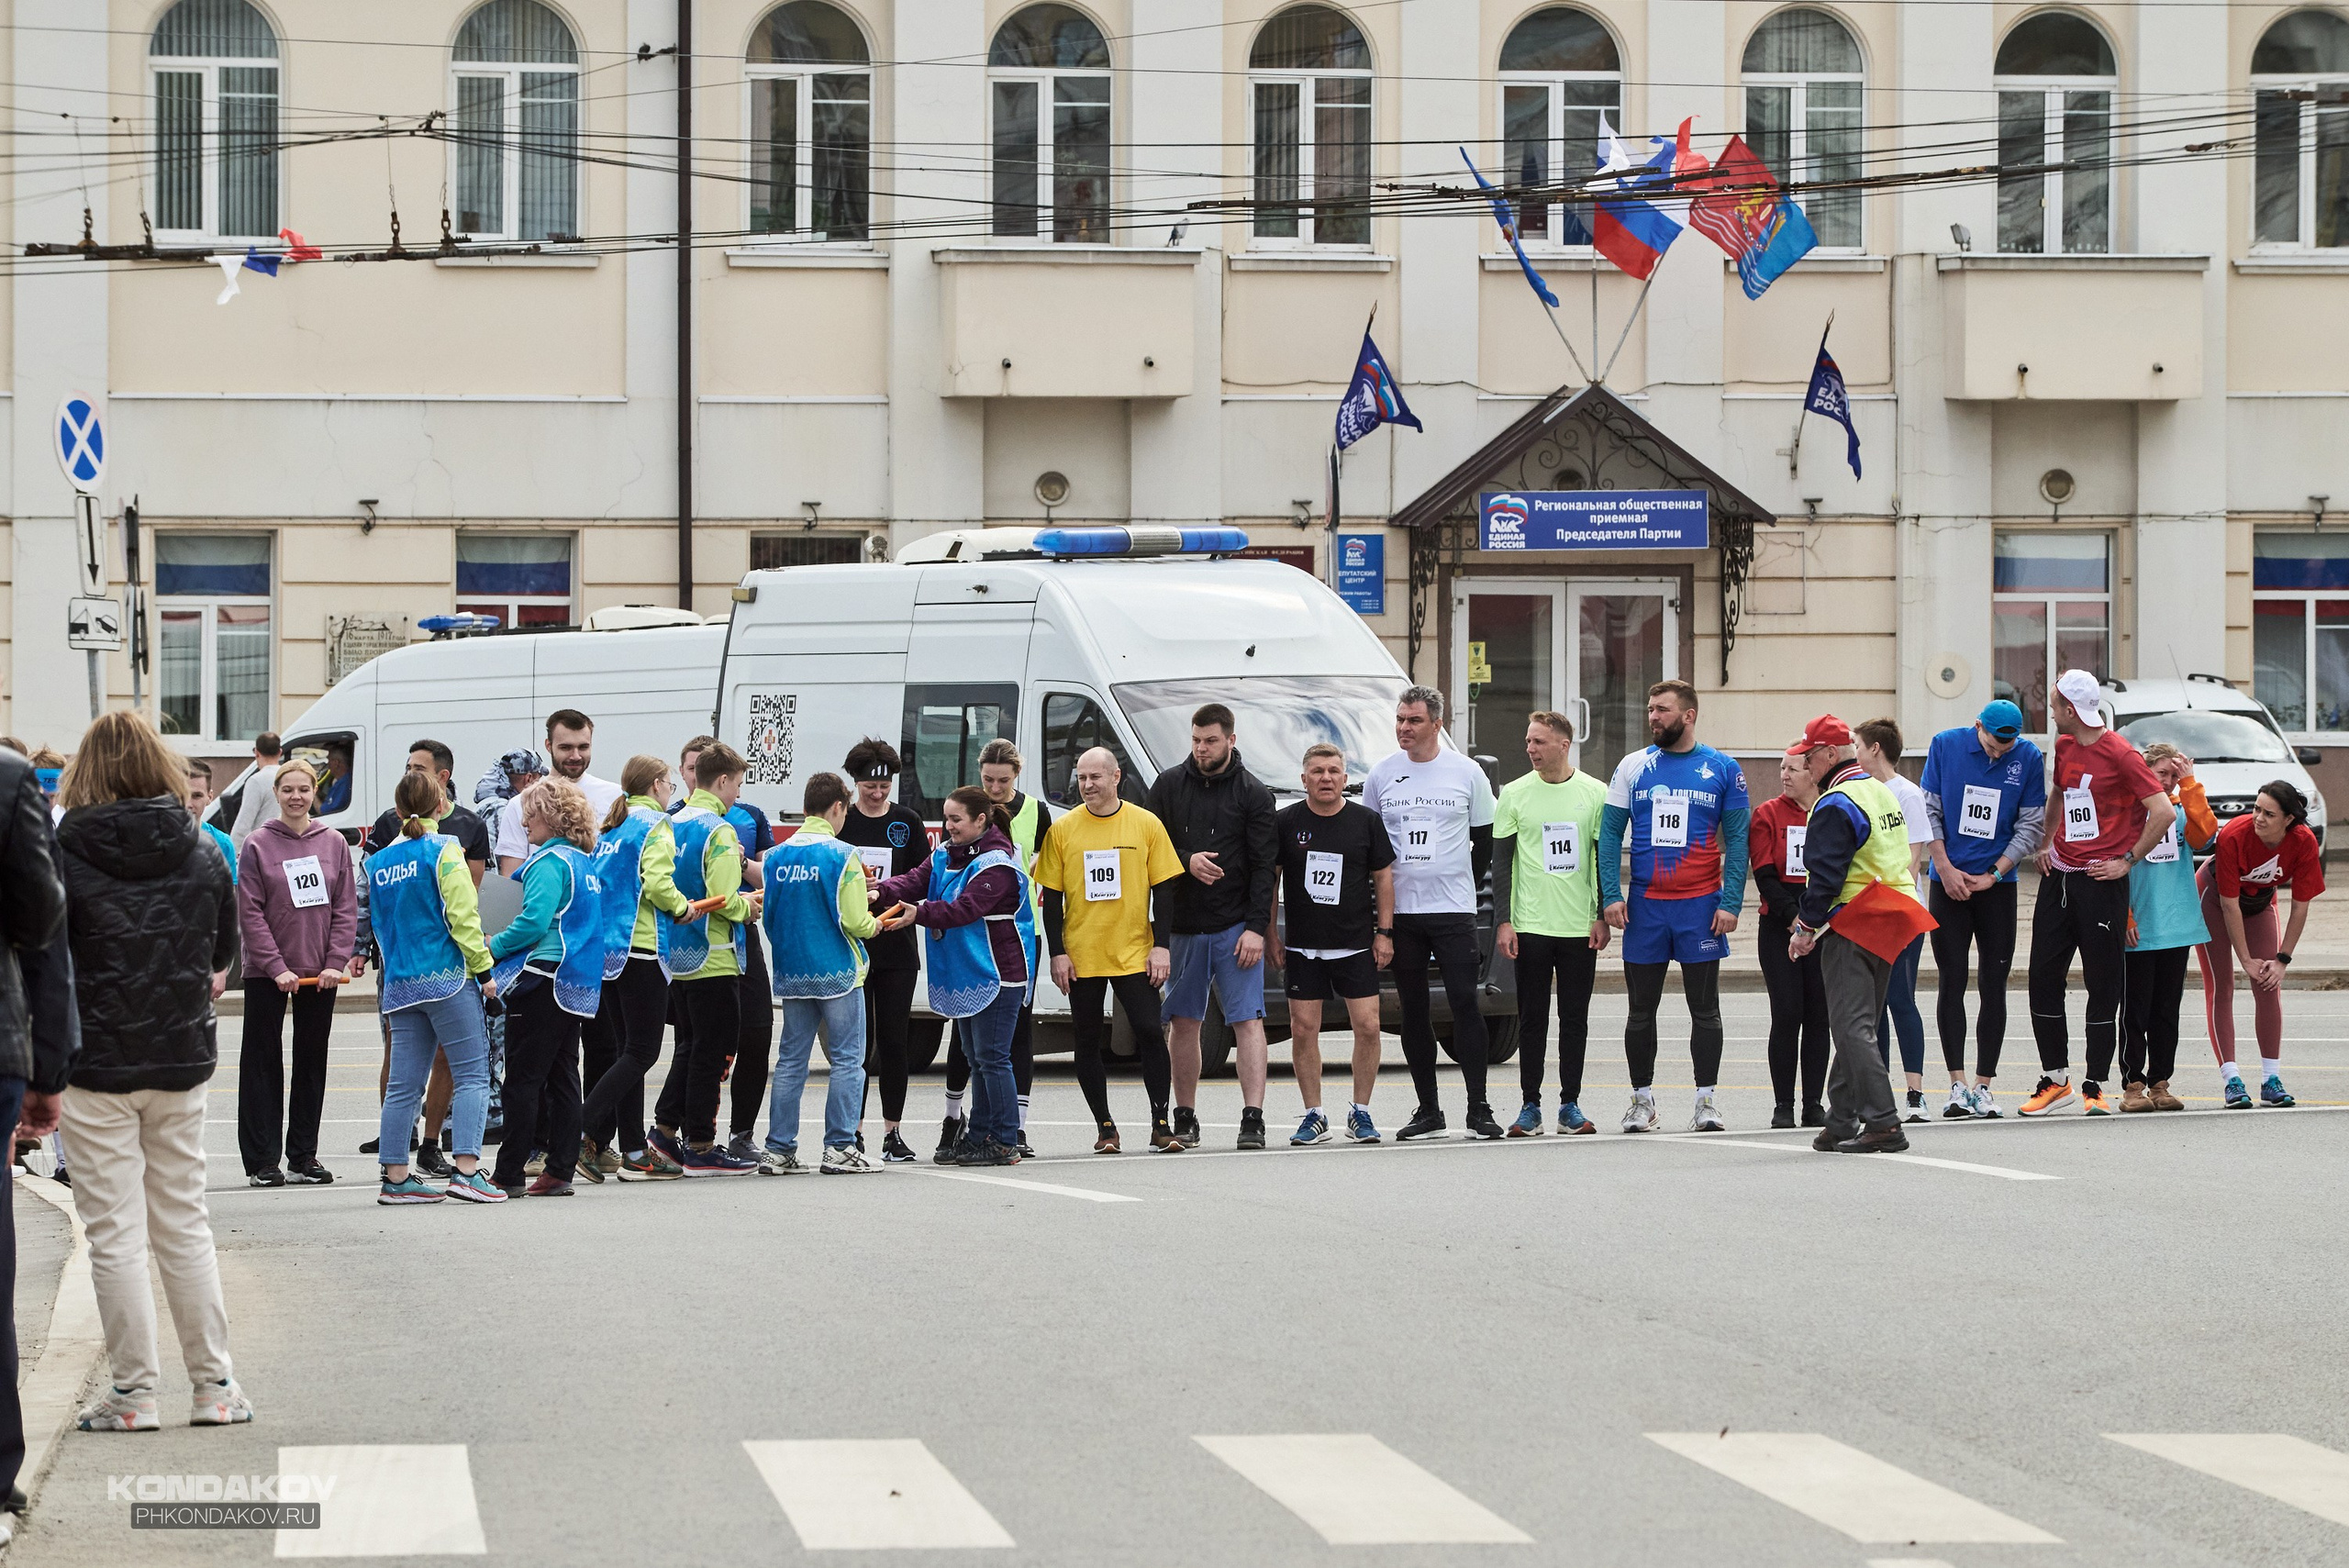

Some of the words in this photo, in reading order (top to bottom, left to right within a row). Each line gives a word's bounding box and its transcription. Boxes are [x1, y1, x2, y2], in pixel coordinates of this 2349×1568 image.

[1340, 402, 1353, 446] РОССИ
[1348, 395, 1363, 439] ЕДИНА
[1534, 499, 1617, 512] Региональная
[1619, 498, 1703, 512] общественная
[1589, 513, 1648, 526] приемная
[1488, 533, 1526, 541] ЕДИНАЯ
[1556, 528, 1637, 542] Председателя
[1639, 528, 1682, 541] Партии
[1488, 540, 1526, 549] РОССИЯ
[377, 629, 393, 640] 1917
[1386, 798, 1411, 807] Банк
[1415, 796, 1456, 807] России
[1635, 790, 1649, 800] ТЭК
[1967, 804, 1992, 821] 103
[2068, 807, 2091, 823] 160
[1659, 814, 1680, 828] 118
[1408, 831, 1428, 845] 117
[1550, 840, 1572, 855] 114
[375, 860, 417, 887] СУДЬЯ
[775, 864, 819, 883] СУДЬЯ
[1090, 867, 1115, 883] 109
[1312, 870, 1336, 886] 122
[294, 873, 319, 890] 120
